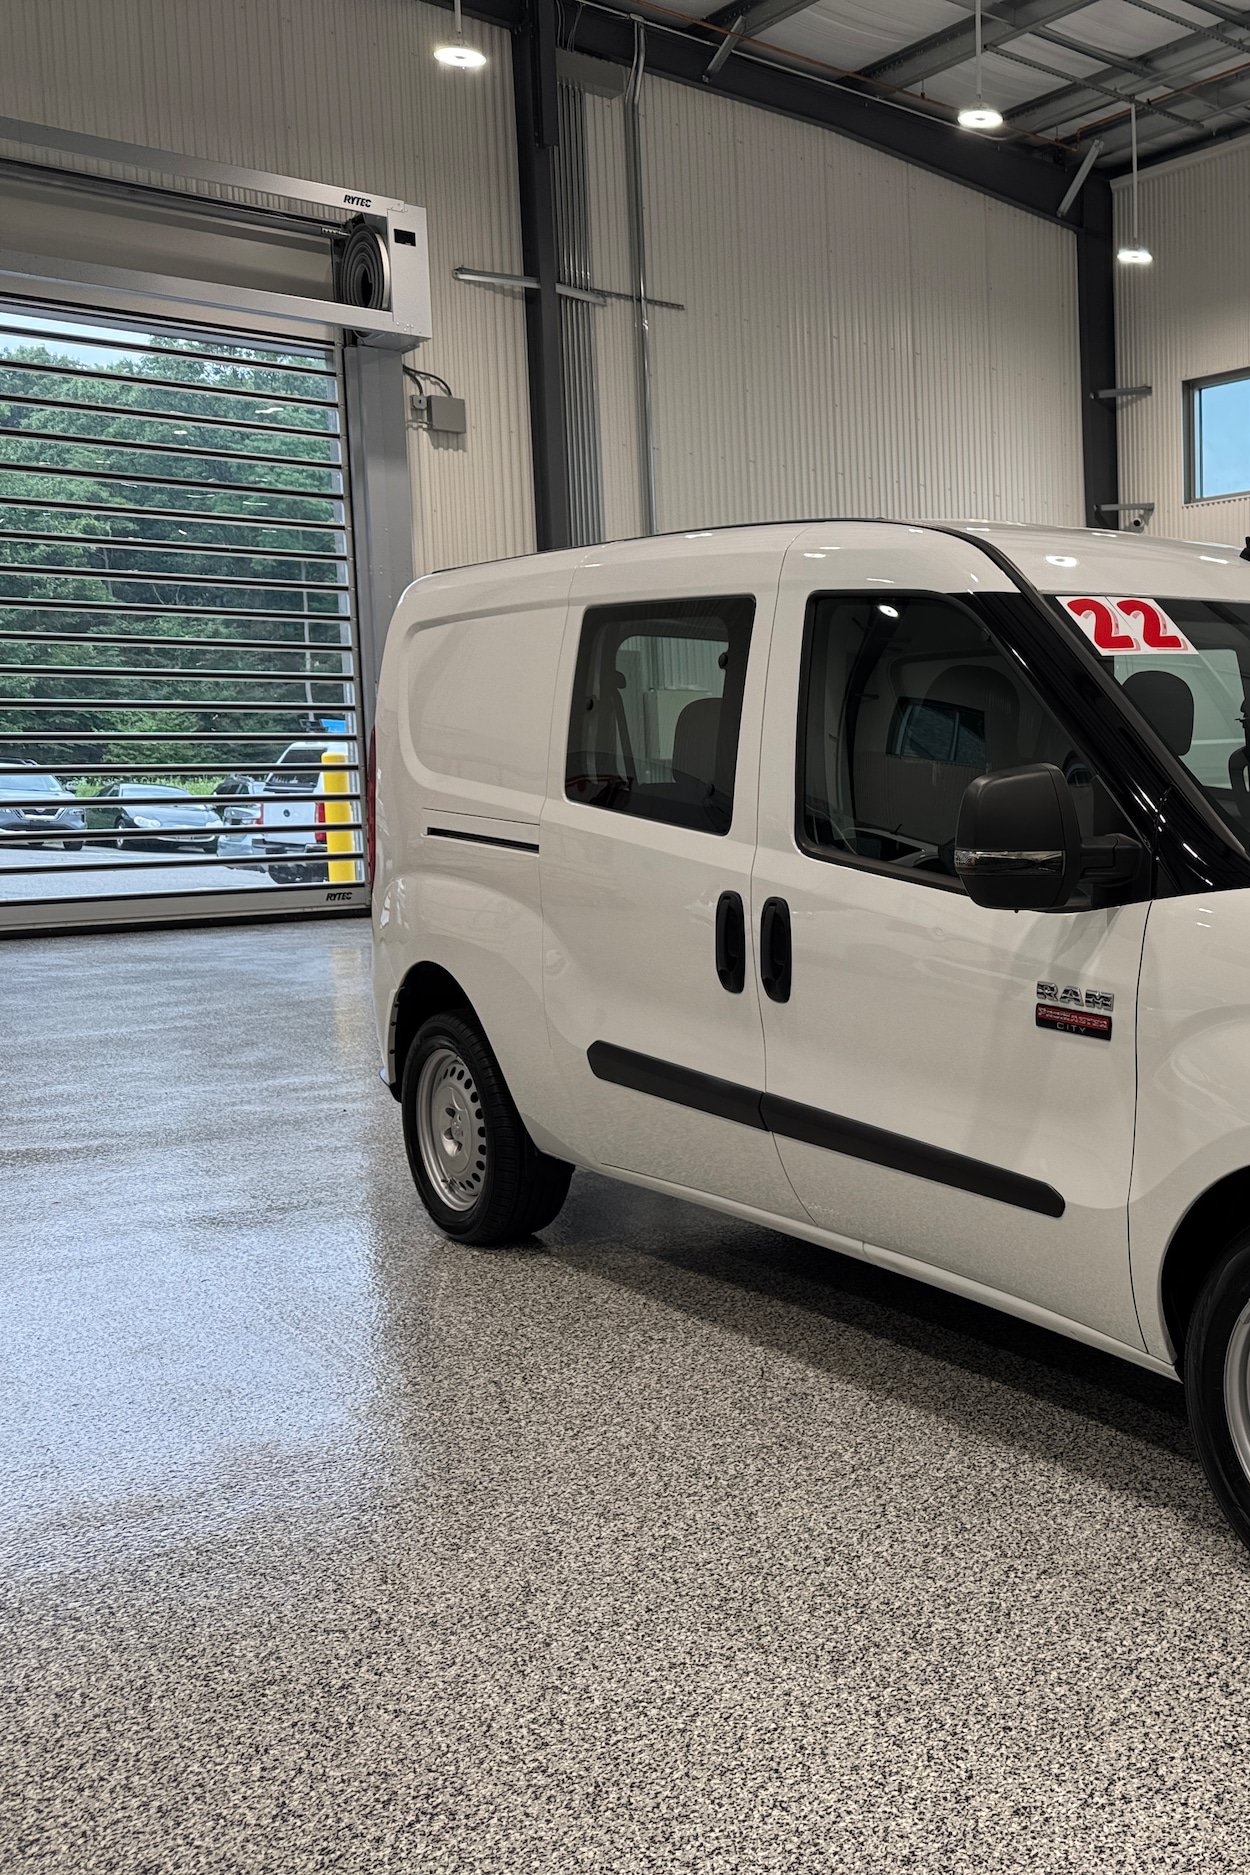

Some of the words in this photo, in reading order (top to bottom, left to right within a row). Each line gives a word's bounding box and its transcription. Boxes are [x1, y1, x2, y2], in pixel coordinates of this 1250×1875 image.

[343, 194, 372, 208] RYTEC
[1067, 598, 1189, 651] 22
[326, 892, 353, 901] RYTEC
[1036, 981, 1115, 1012] RAM
[1056, 1022, 1087, 1033] CITY
